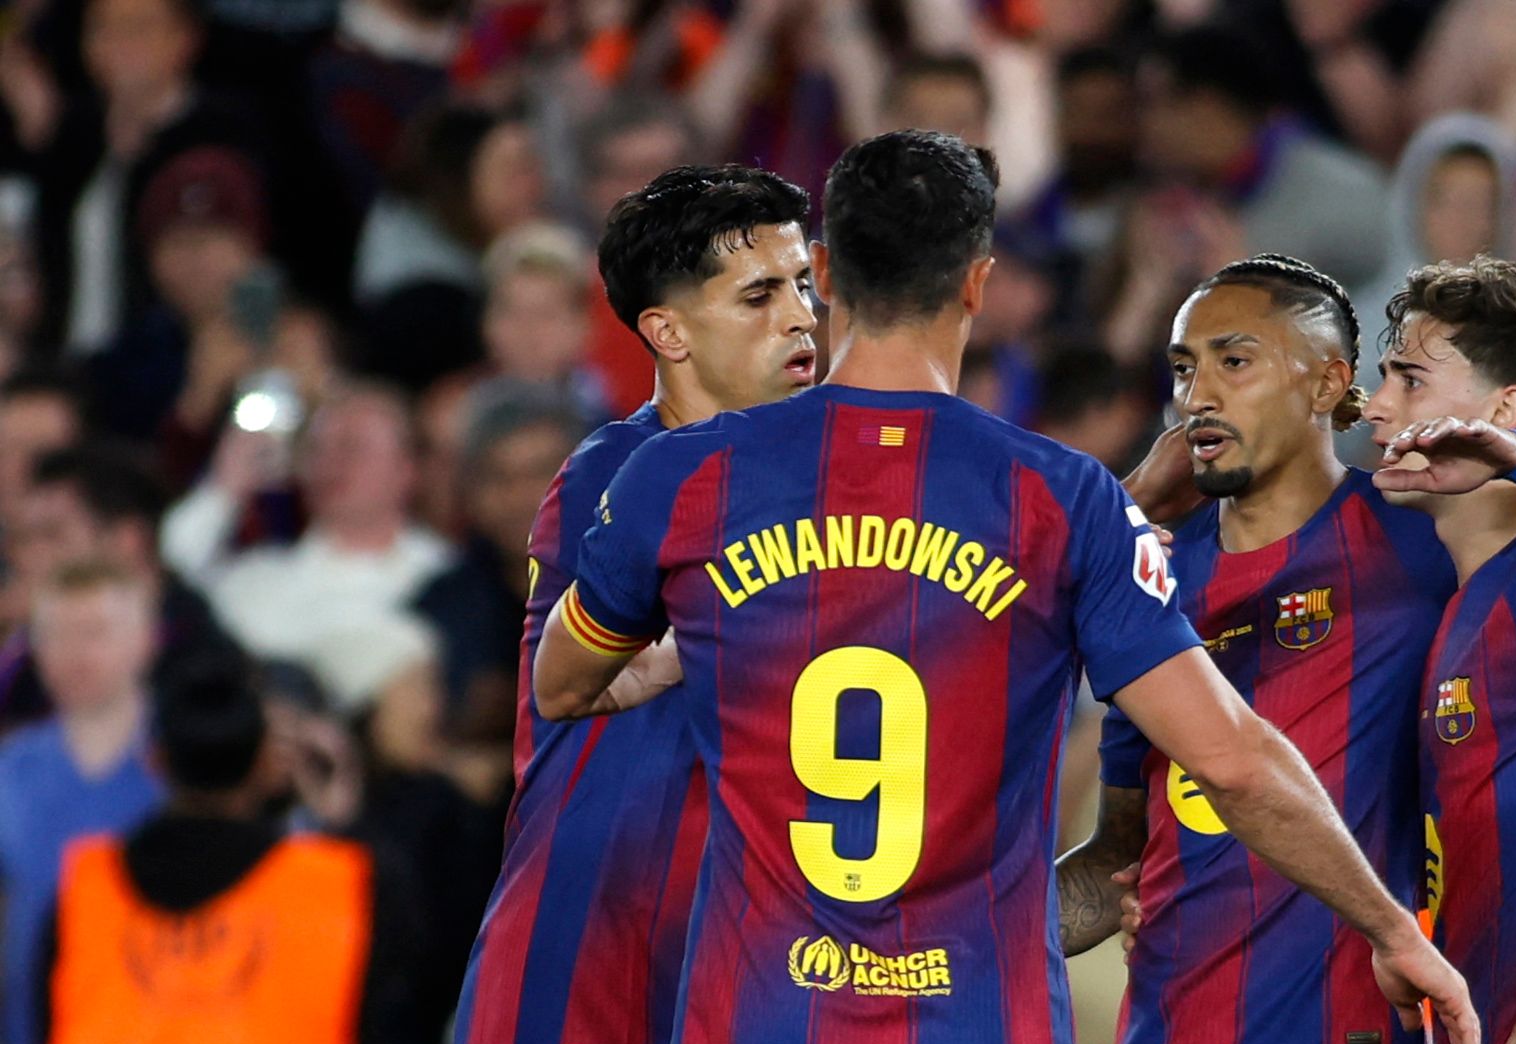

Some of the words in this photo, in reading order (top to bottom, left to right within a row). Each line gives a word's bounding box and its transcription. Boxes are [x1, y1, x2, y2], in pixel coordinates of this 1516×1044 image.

[704, 515, 1027, 621] LEWANDOWSKI
[789, 645, 928, 903] 9
[850, 943, 949, 973] UNHCR
[853, 964, 951, 989] ACNUR
